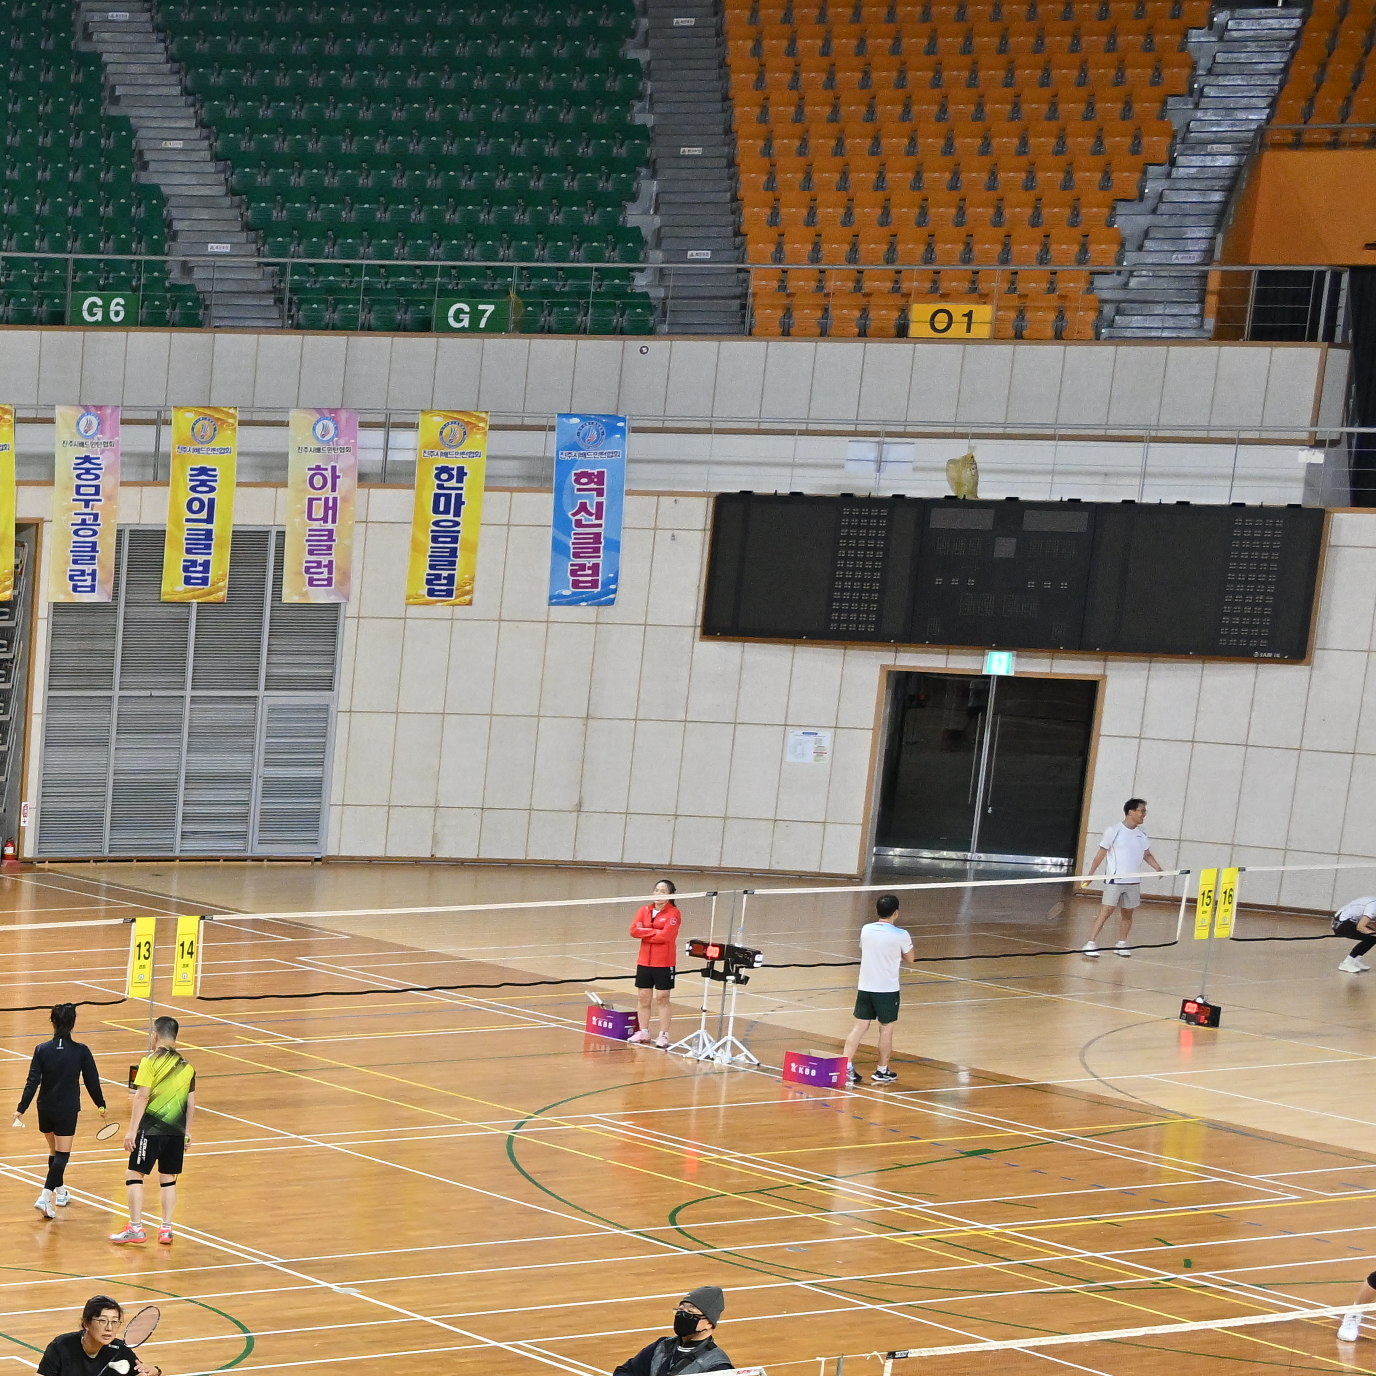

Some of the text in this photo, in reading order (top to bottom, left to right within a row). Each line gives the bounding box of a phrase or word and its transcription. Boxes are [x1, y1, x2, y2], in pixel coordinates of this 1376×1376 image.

[80, 296, 126, 324] G6
[447, 303, 496, 329] G7
[68, 454, 103, 594] 충무공클럽
[182, 465, 218, 588] 충의클럽
[304, 464, 341, 588] 하대클럽
[425, 465, 468, 599] 한마음클럽
[569, 469, 606, 591] 혁신클럽
[1200, 889, 1213, 907] 15
[1222, 887, 1234, 906] 16
[136, 940, 151, 961] 13
[179, 940, 194, 960] 14
[598, 1019, 612, 1030] KBB
[798, 1066, 816, 1077] KBB
